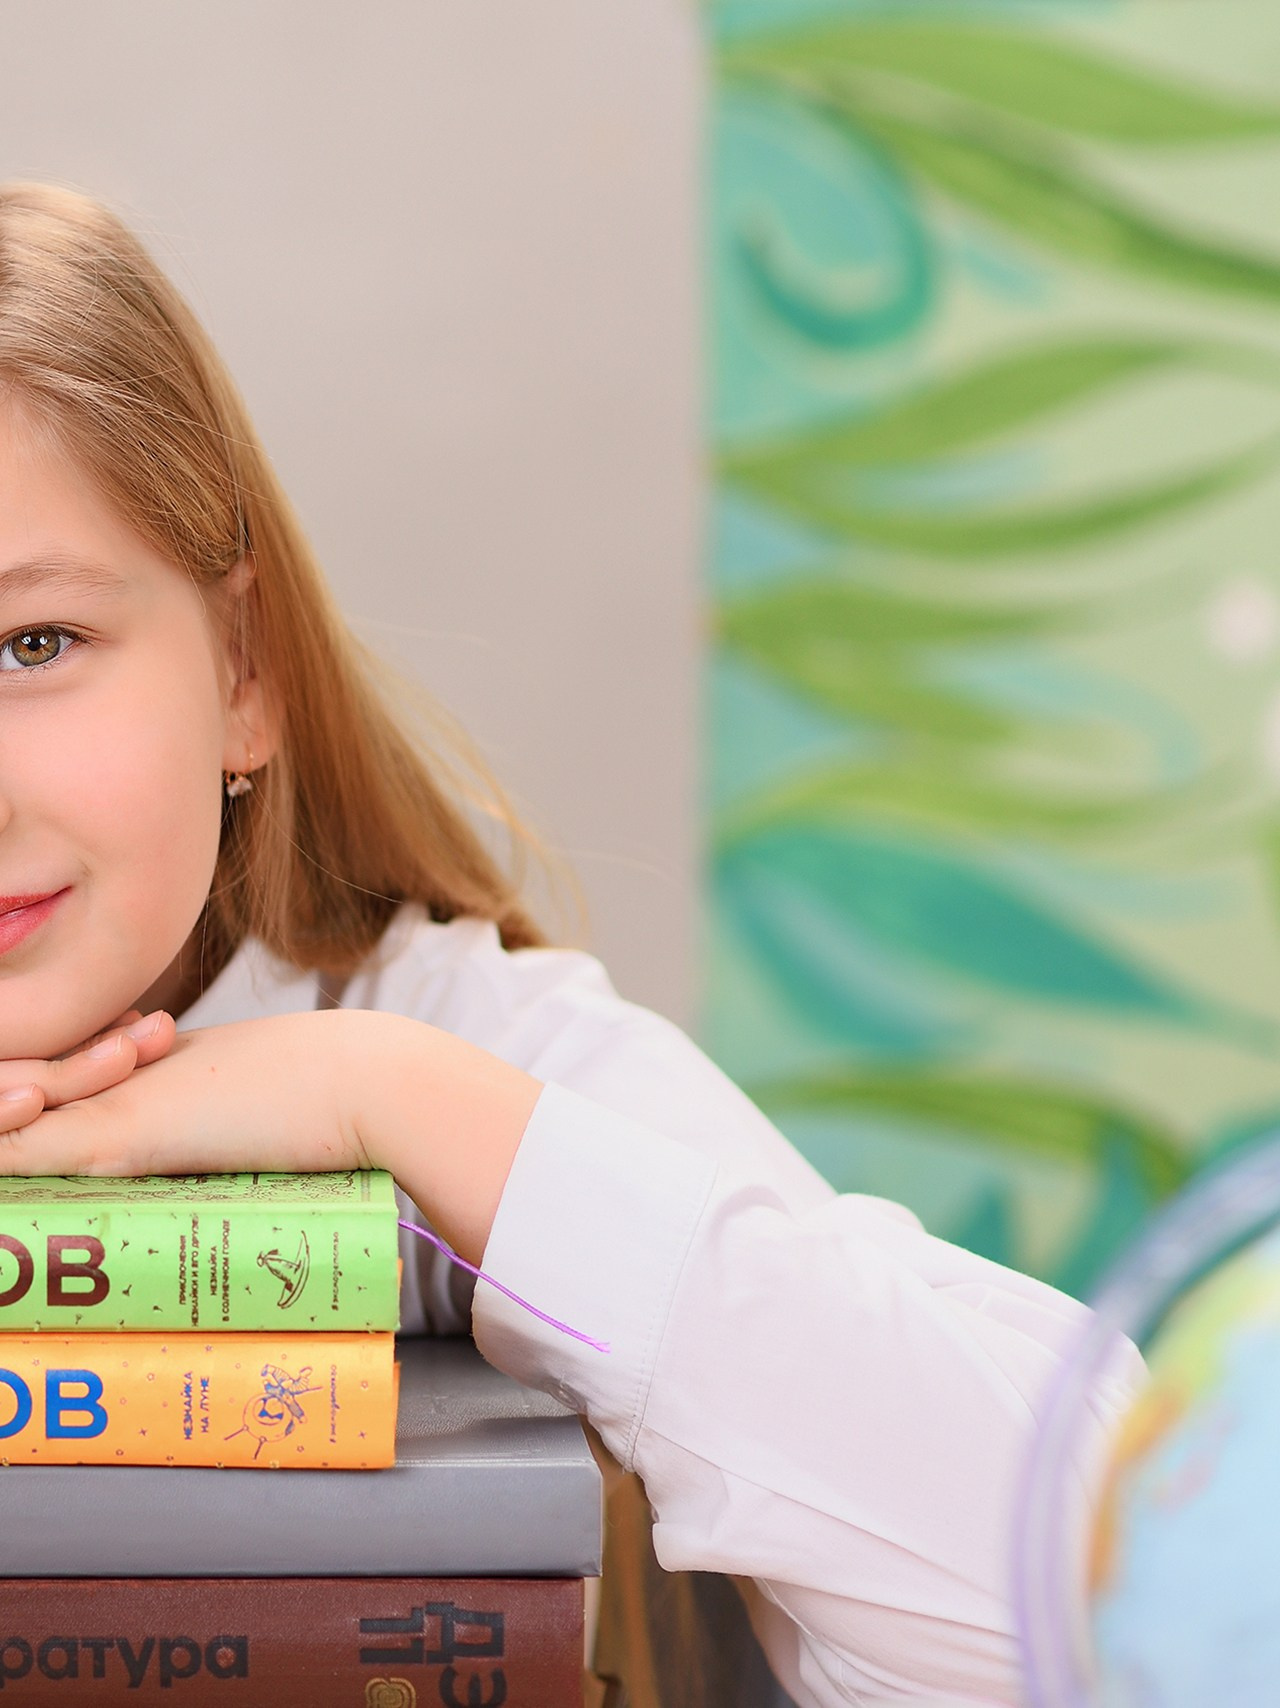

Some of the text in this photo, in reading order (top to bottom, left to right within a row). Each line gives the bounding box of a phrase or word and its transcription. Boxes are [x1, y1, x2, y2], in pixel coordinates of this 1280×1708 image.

[222, 1219, 231, 1255] ГОРОДЕ
[179, 1235, 187, 1305] ПРИКЛЮЧЕНИЯ
[208, 1246, 217, 1296] НЕЗНАЙКА
[190, 1280, 199, 1327] НЕЗНАЙКИ
[180, 1371, 193, 1440] НЕЗНАЙКА
[200, 1376, 209, 1433] НА ЛУНЕ
